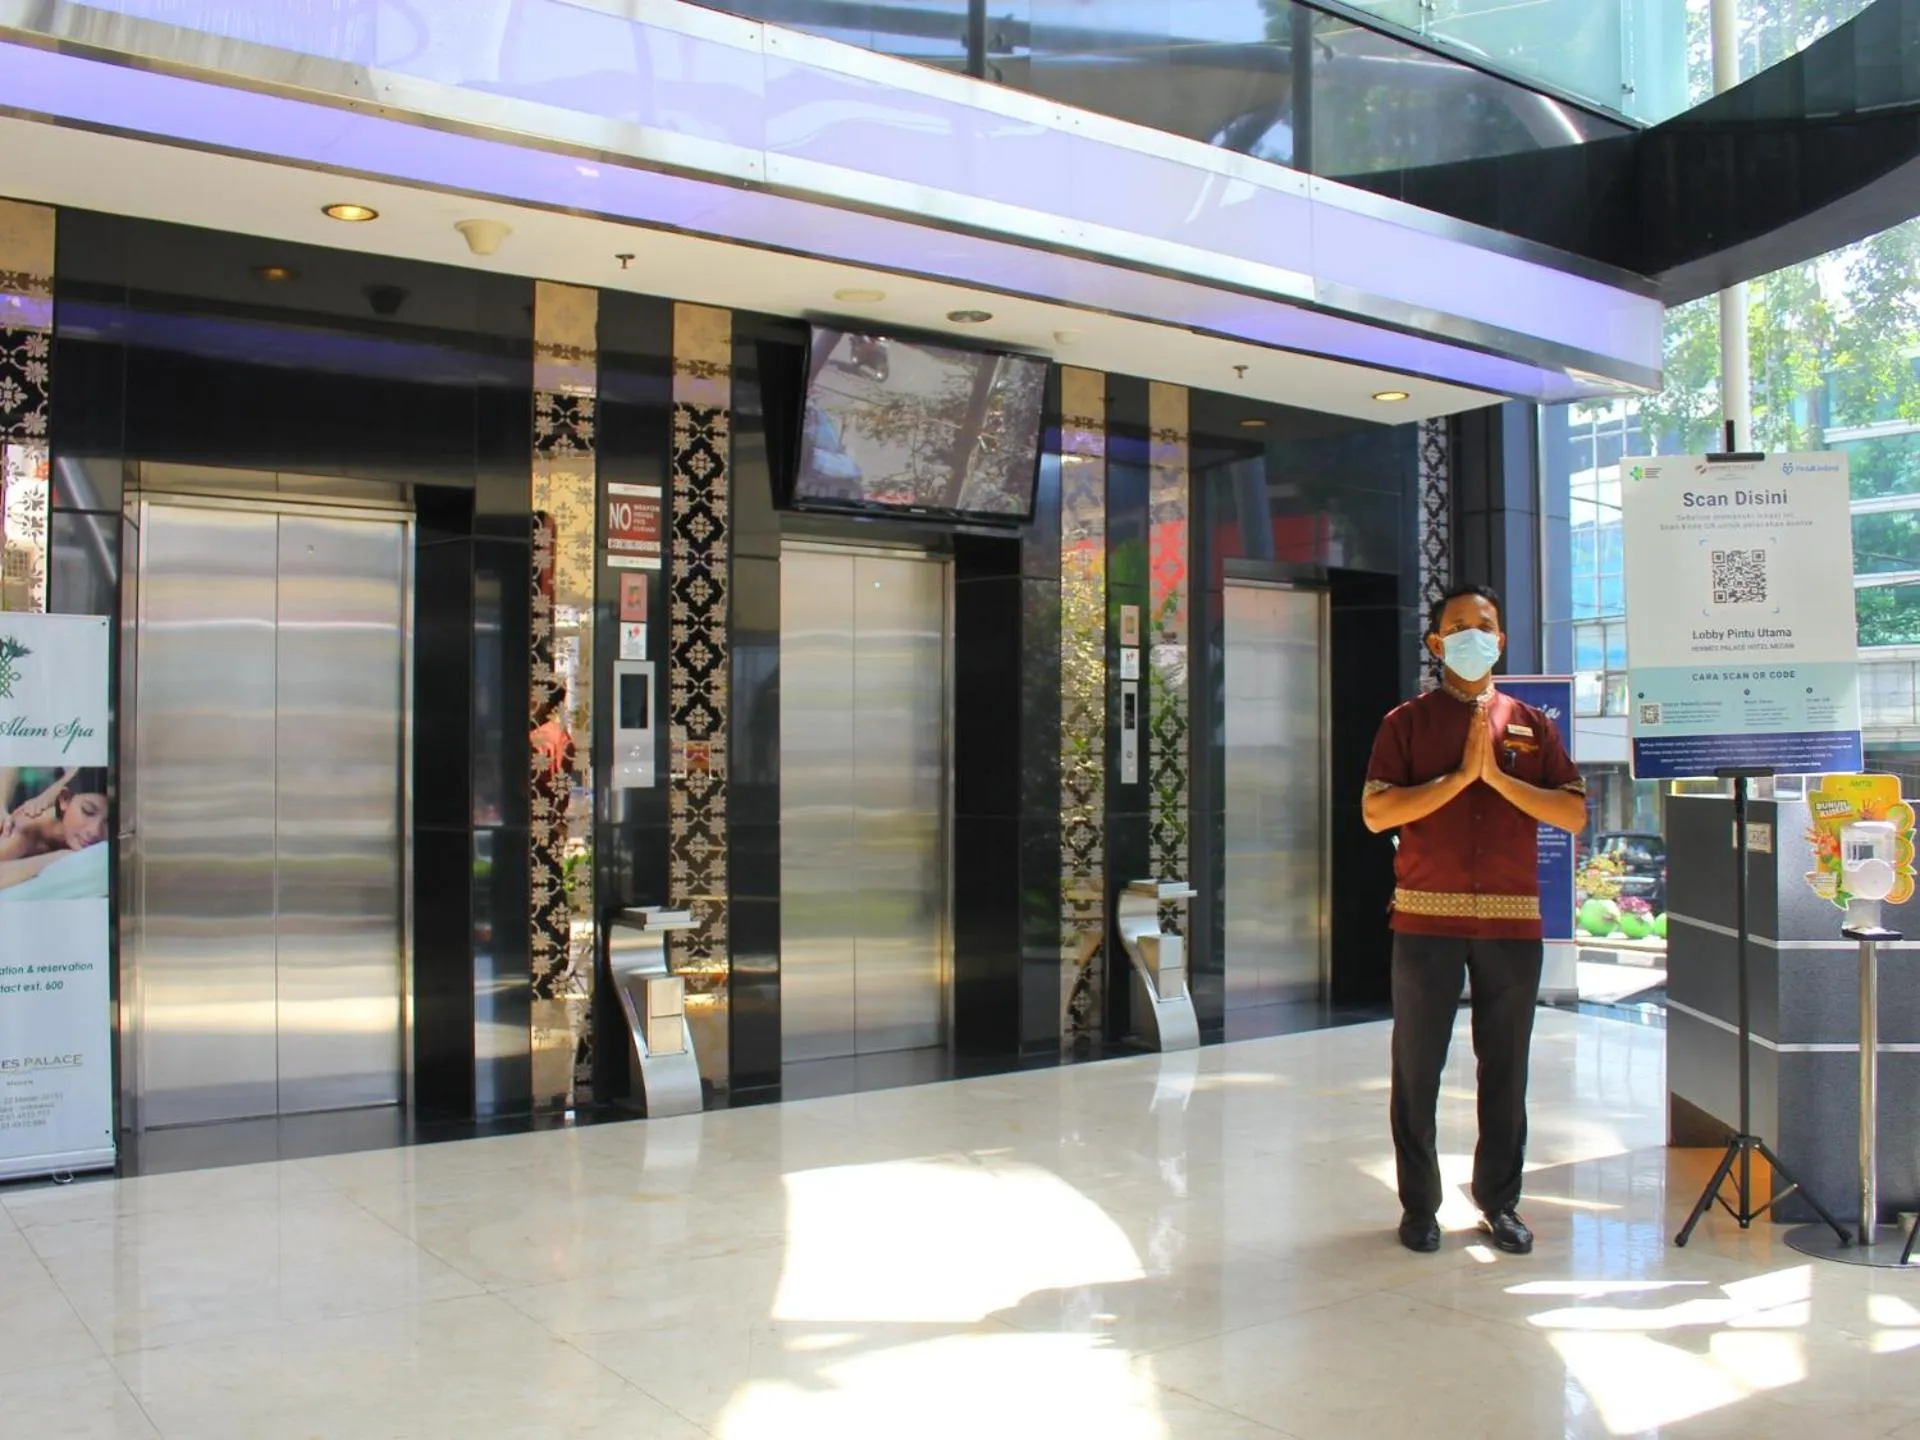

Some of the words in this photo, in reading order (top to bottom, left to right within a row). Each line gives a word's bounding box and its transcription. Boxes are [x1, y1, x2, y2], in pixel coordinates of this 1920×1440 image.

[1683, 491, 1728, 508] Scan
[1735, 489, 1788, 505] Disini
[608, 502, 632, 532] NO
[1692, 629, 1724, 641] Lobby
[1727, 628, 1755, 639] Pintu
[1757, 627, 1792, 638] Utama
[1692, 672, 1719, 681] CARA
[1722, 671, 1750, 680] SCAN
[1769, 670, 1795, 679] CODE
[53, 716, 95, 754] Spa
[27, 965, 34, 974] &
[36, 962, 94, 974] reservation
[45, 980, 64, 991] 600
[24, 1053, 83, 1068] PALACE
